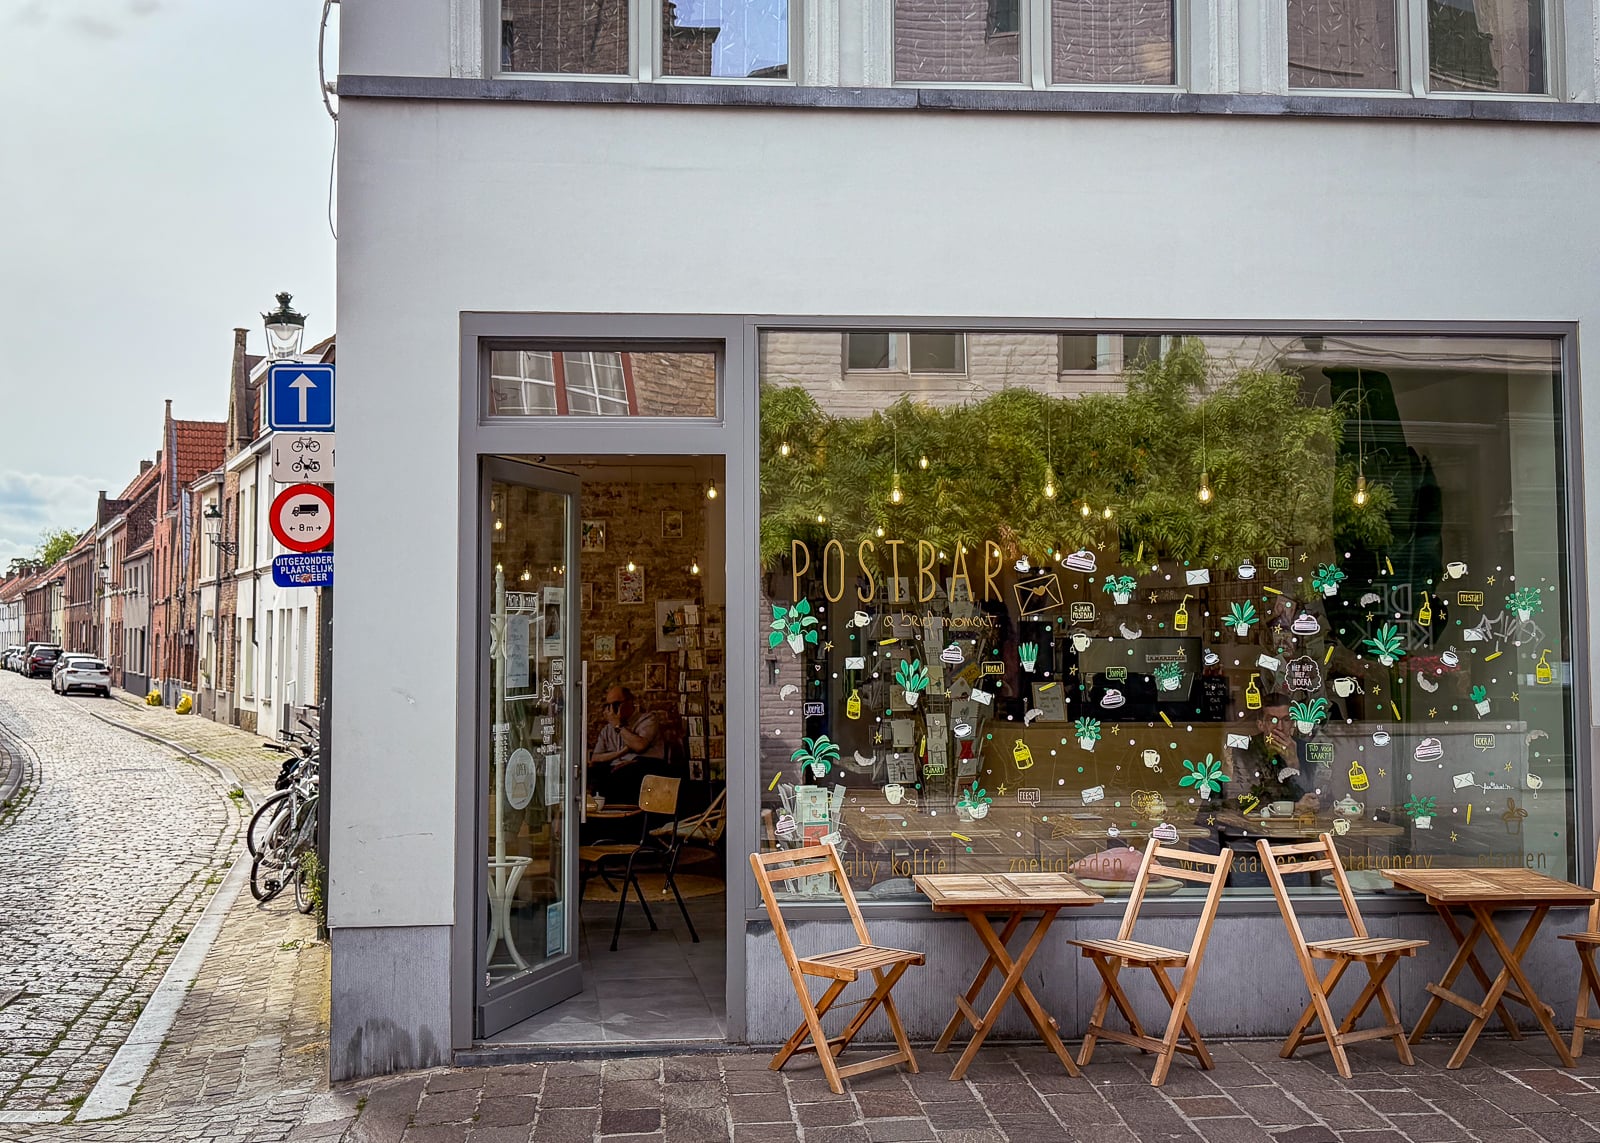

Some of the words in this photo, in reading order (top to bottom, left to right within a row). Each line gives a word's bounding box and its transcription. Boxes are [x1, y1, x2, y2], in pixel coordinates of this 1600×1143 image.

[299, 523, 305, 531] 8
[275, 556, 333, 566] UITGEZONDER
[280, 565, 333, 575] PLAATSELIJK
[791, 540, 1003, 602] POSTBAR
[290, 573, 328, 583] VEEER
[900, 608, 935, 640] brief
[1020, 790, 1039, 800] FEEST!
[891, 848, 946, 877] koffie
